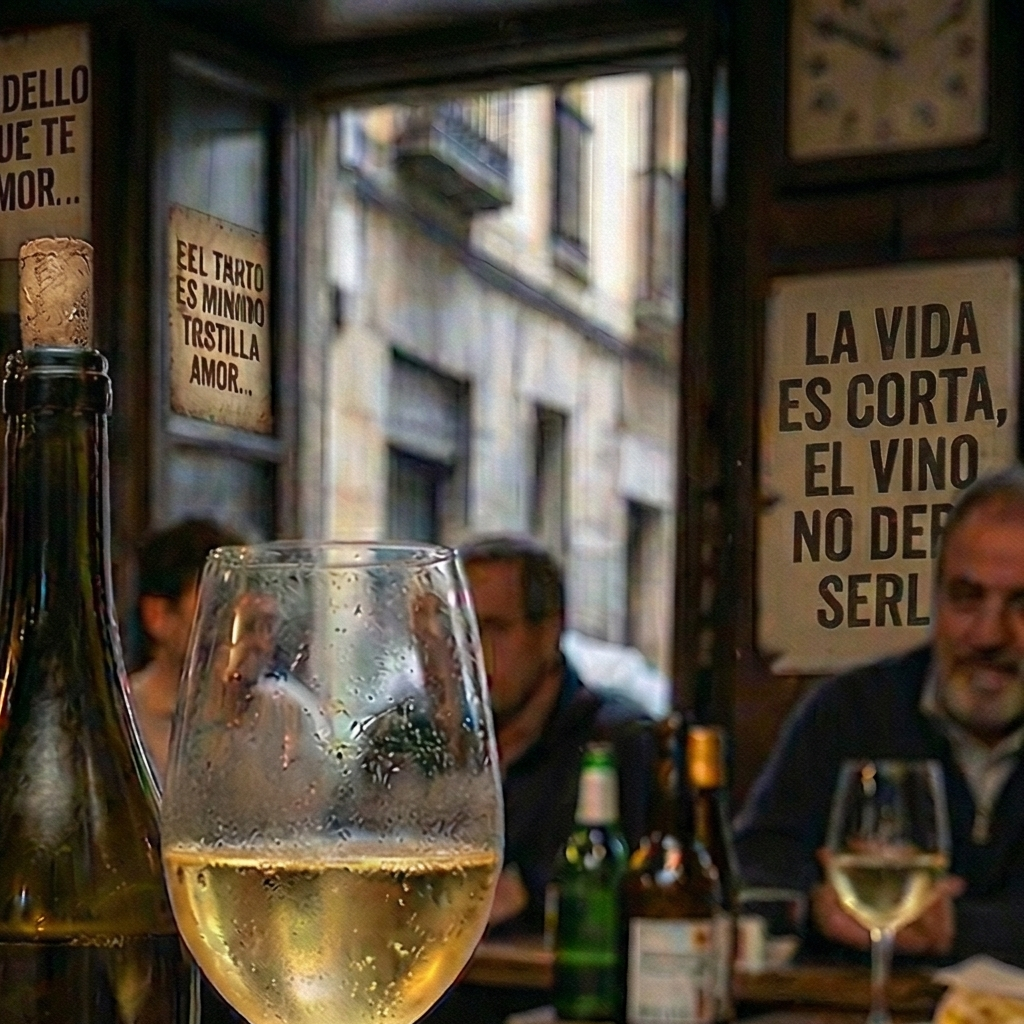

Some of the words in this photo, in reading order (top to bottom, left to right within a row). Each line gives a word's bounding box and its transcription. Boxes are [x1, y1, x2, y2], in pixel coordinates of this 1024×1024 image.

[41, 115, 76, 157] TE
[176, 275, 198, 310] ES
[805, 310, 858, 366] LA
[875, 301, 981, 361] VIDA
[189, 354, 253, 397] AMOR...
[779, 376, 832, 432] ES
[847, 366, 1008, 428] CORTA,
[805, 441, 854, 497] EL
[870, 434, 979, 494] VINO
[793, 508, 853, 563] NO
